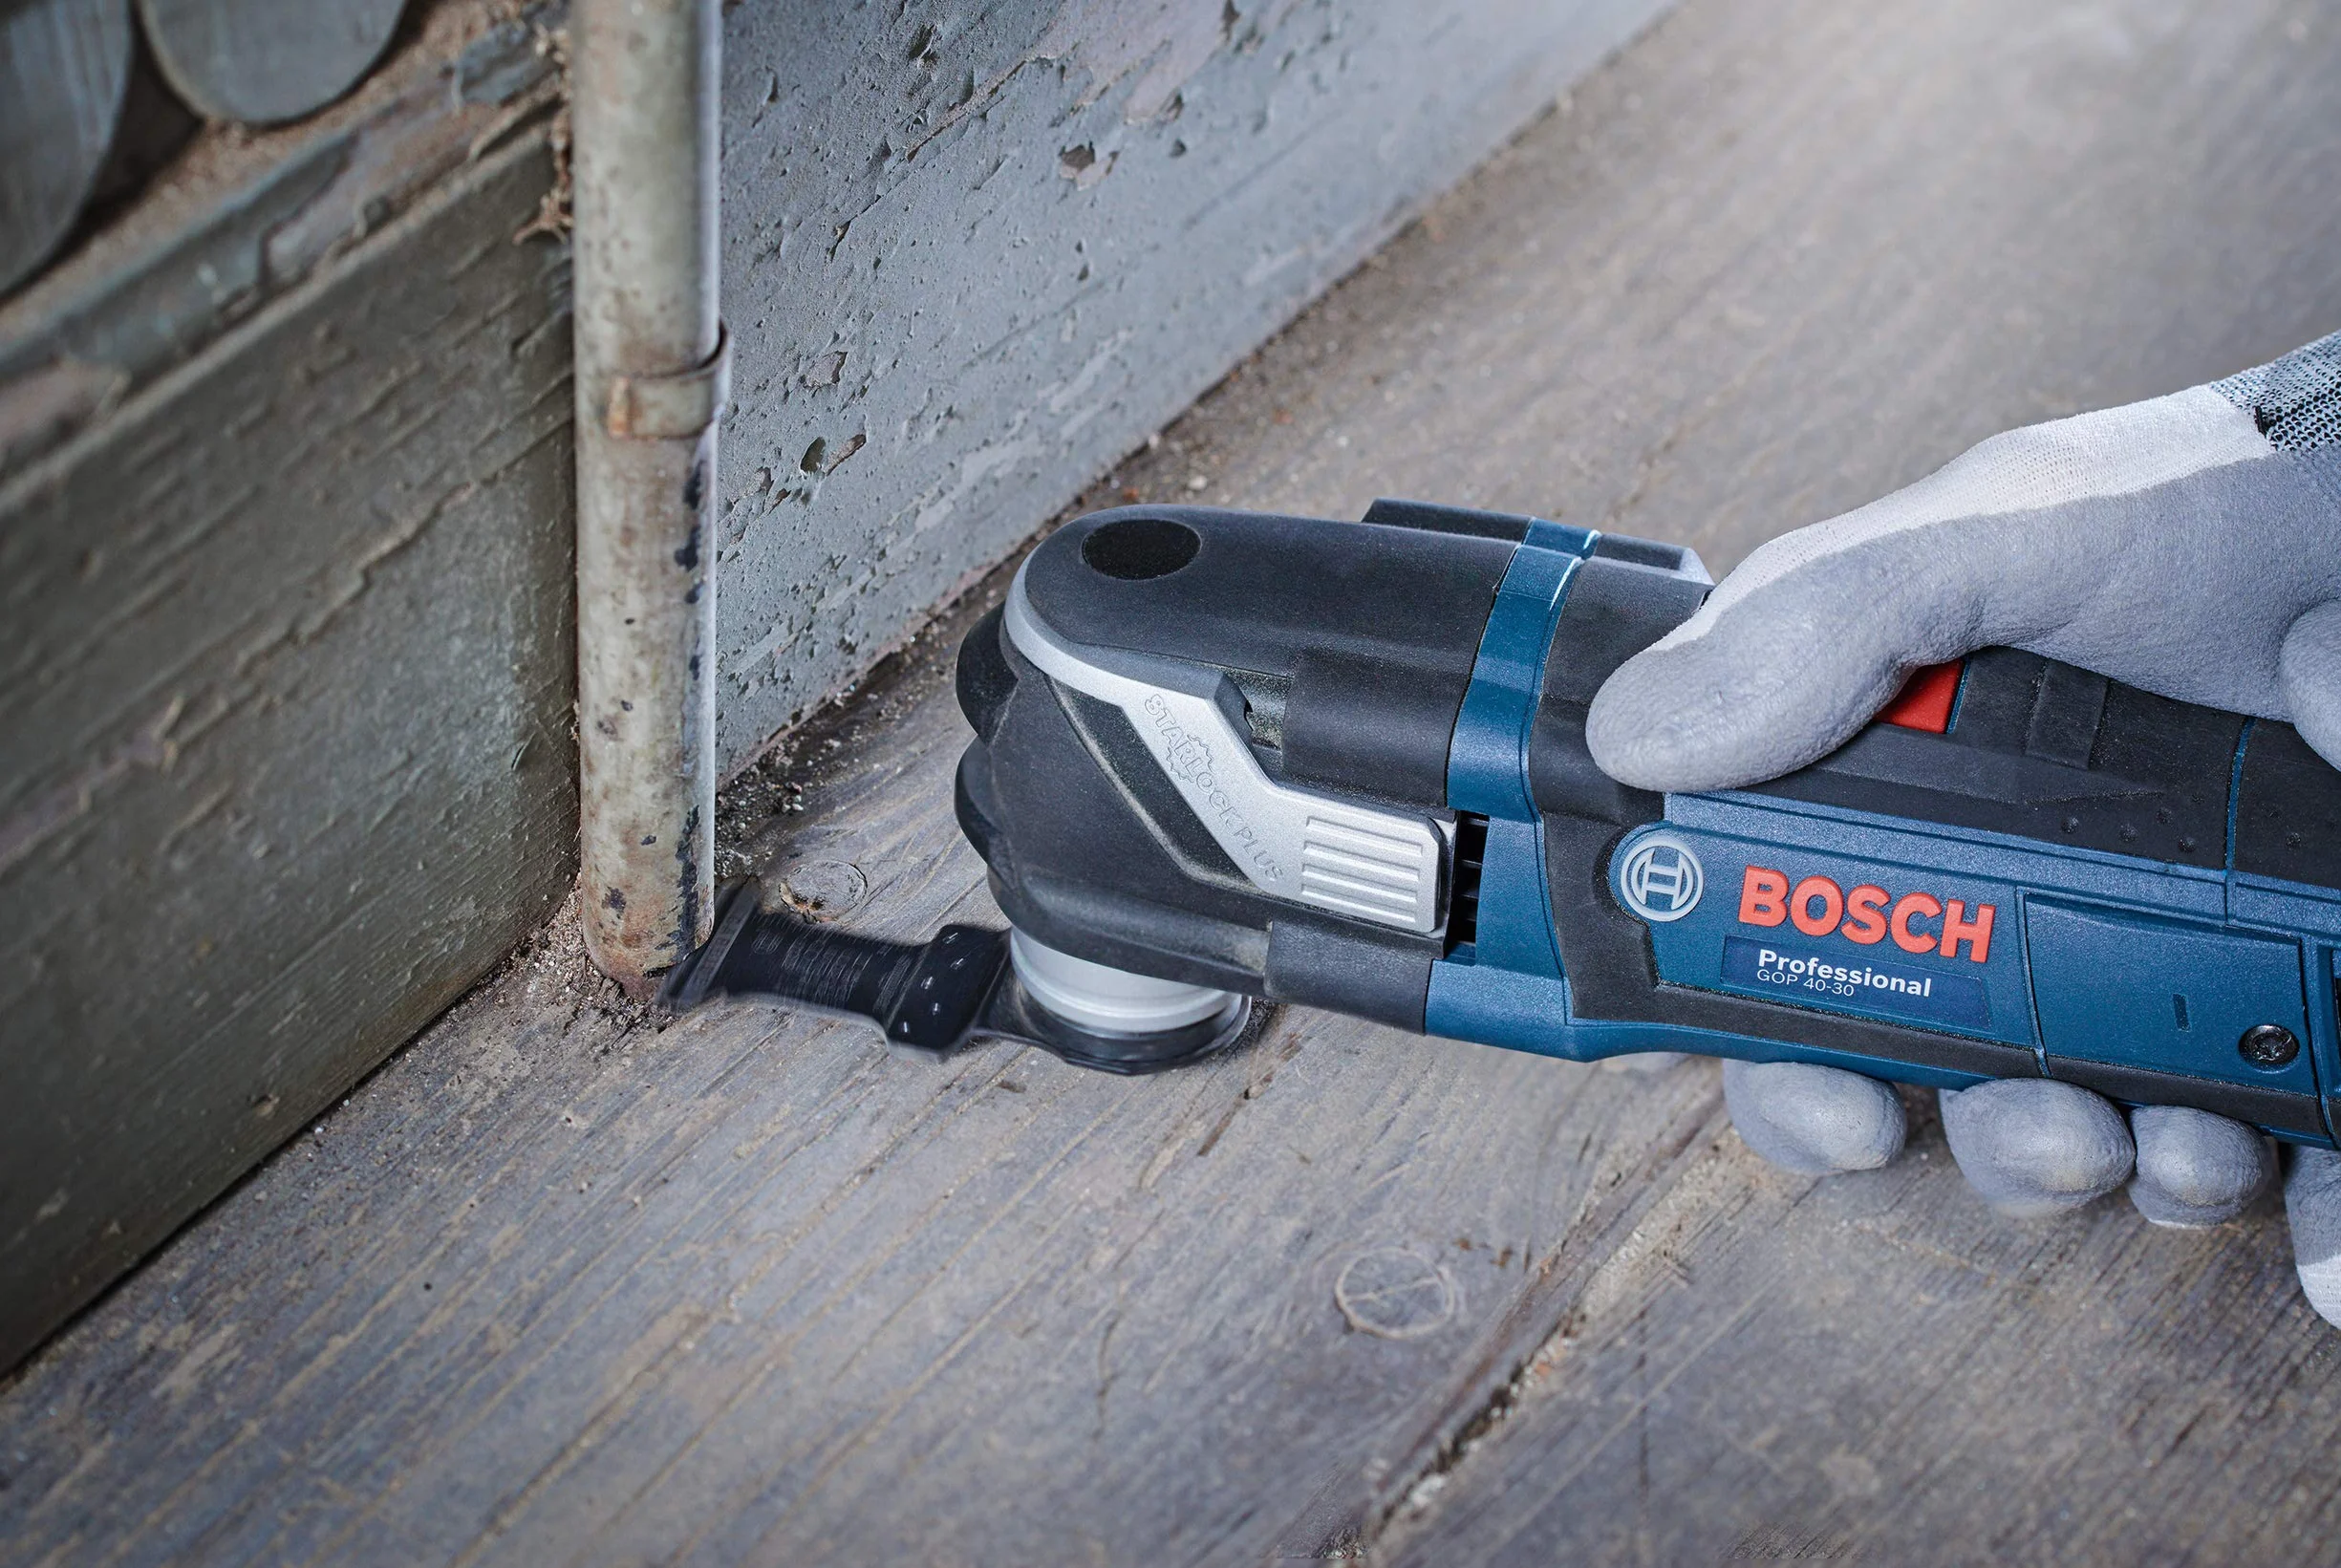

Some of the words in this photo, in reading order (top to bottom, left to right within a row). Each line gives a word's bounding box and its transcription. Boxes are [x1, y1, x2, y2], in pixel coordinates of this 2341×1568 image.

[1234, 826, 1283, 881] PLUS
[1738, 865, 1996, 963] BOSCH
[1756, 969, 1798, 985] GOP
[1803, 977, 1855, 997] 40-30
[1758, 949, 1932, 998] Professional
